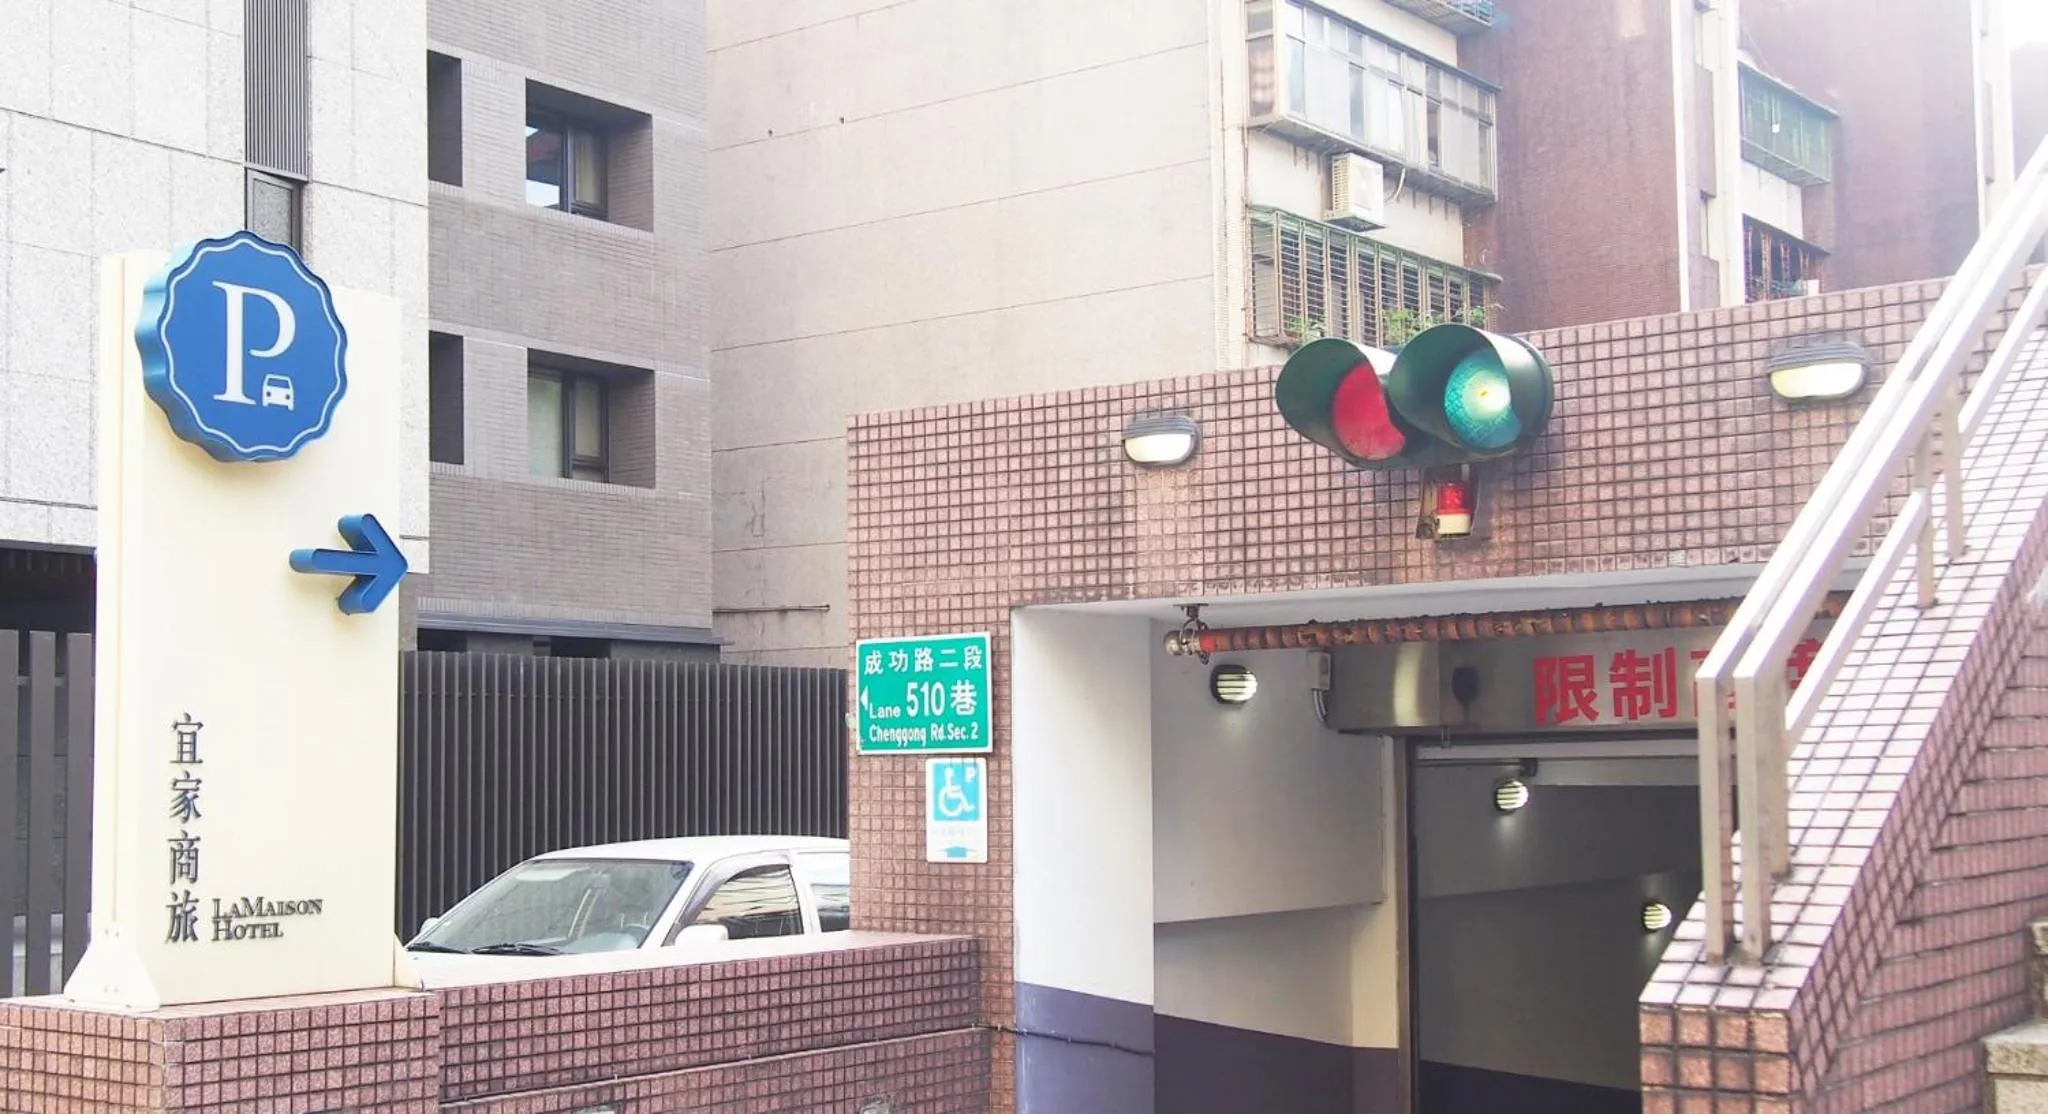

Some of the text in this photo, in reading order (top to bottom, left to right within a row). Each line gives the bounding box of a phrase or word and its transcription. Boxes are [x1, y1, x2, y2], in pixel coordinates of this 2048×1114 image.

[212, 280, 296, 405] P
[864, 645, 982, 675] 成功路二段
[869, 703, 901, 719] Lane
[906, 681, 946, 717] 510
[869, 724, 926, 747] Chenggong
[971, 721, 979, 740] 2
[165, 712, 204, 943] 宜家商旅
